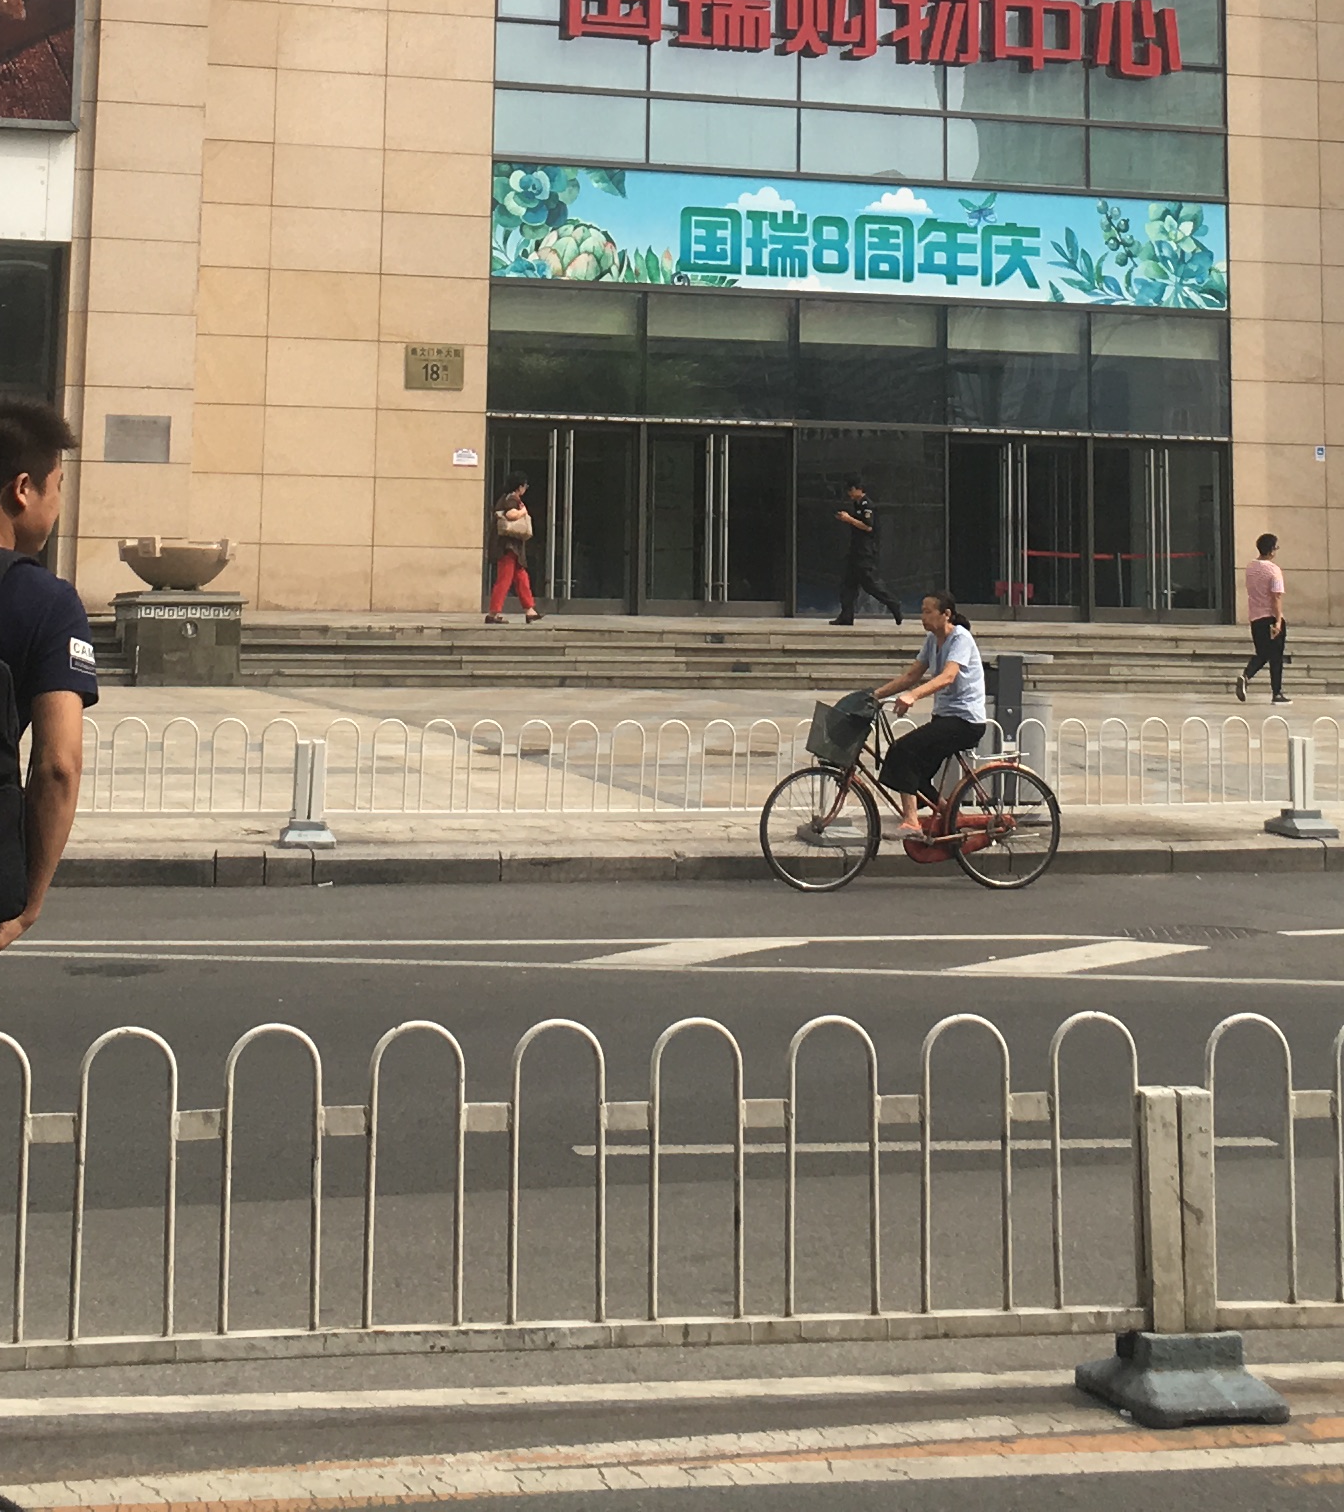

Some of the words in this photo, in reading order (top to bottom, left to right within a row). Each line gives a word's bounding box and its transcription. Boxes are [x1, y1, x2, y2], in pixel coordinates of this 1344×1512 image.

[677, 206, 1042, 289] 国瑞8周年庆
[421, 363, 440, 382] 18
